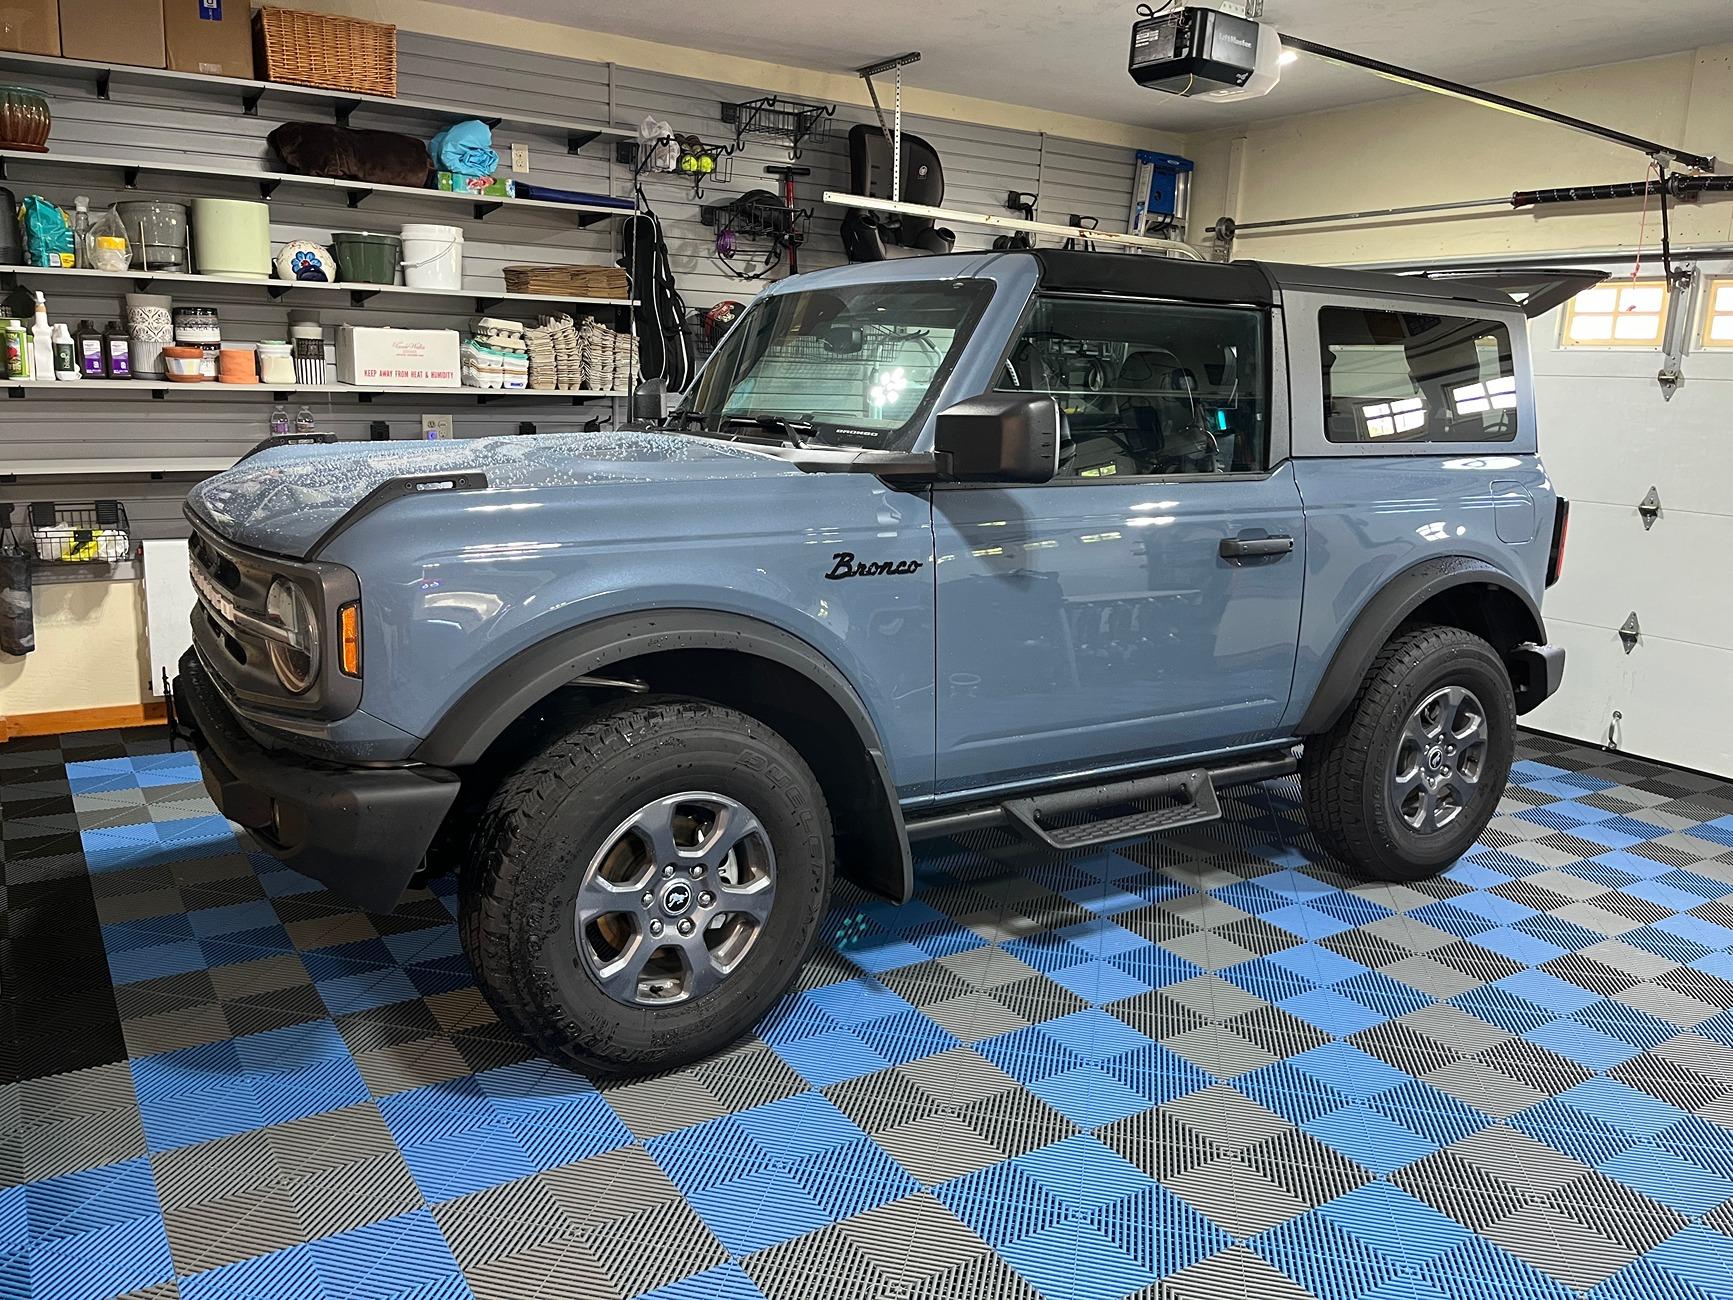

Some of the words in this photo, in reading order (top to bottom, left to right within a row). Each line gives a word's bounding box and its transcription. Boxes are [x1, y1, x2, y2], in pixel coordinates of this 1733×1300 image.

[364, 369, 377, 377] KEEP
[379, 370, 393, 378] AWAY
[395, 370, 409, 378] FROM
[431, 371, 454, 379] HUMIDITY
[835, 428, 879, 437] BRONCO
[824, 551, 924, 580] Bronco
